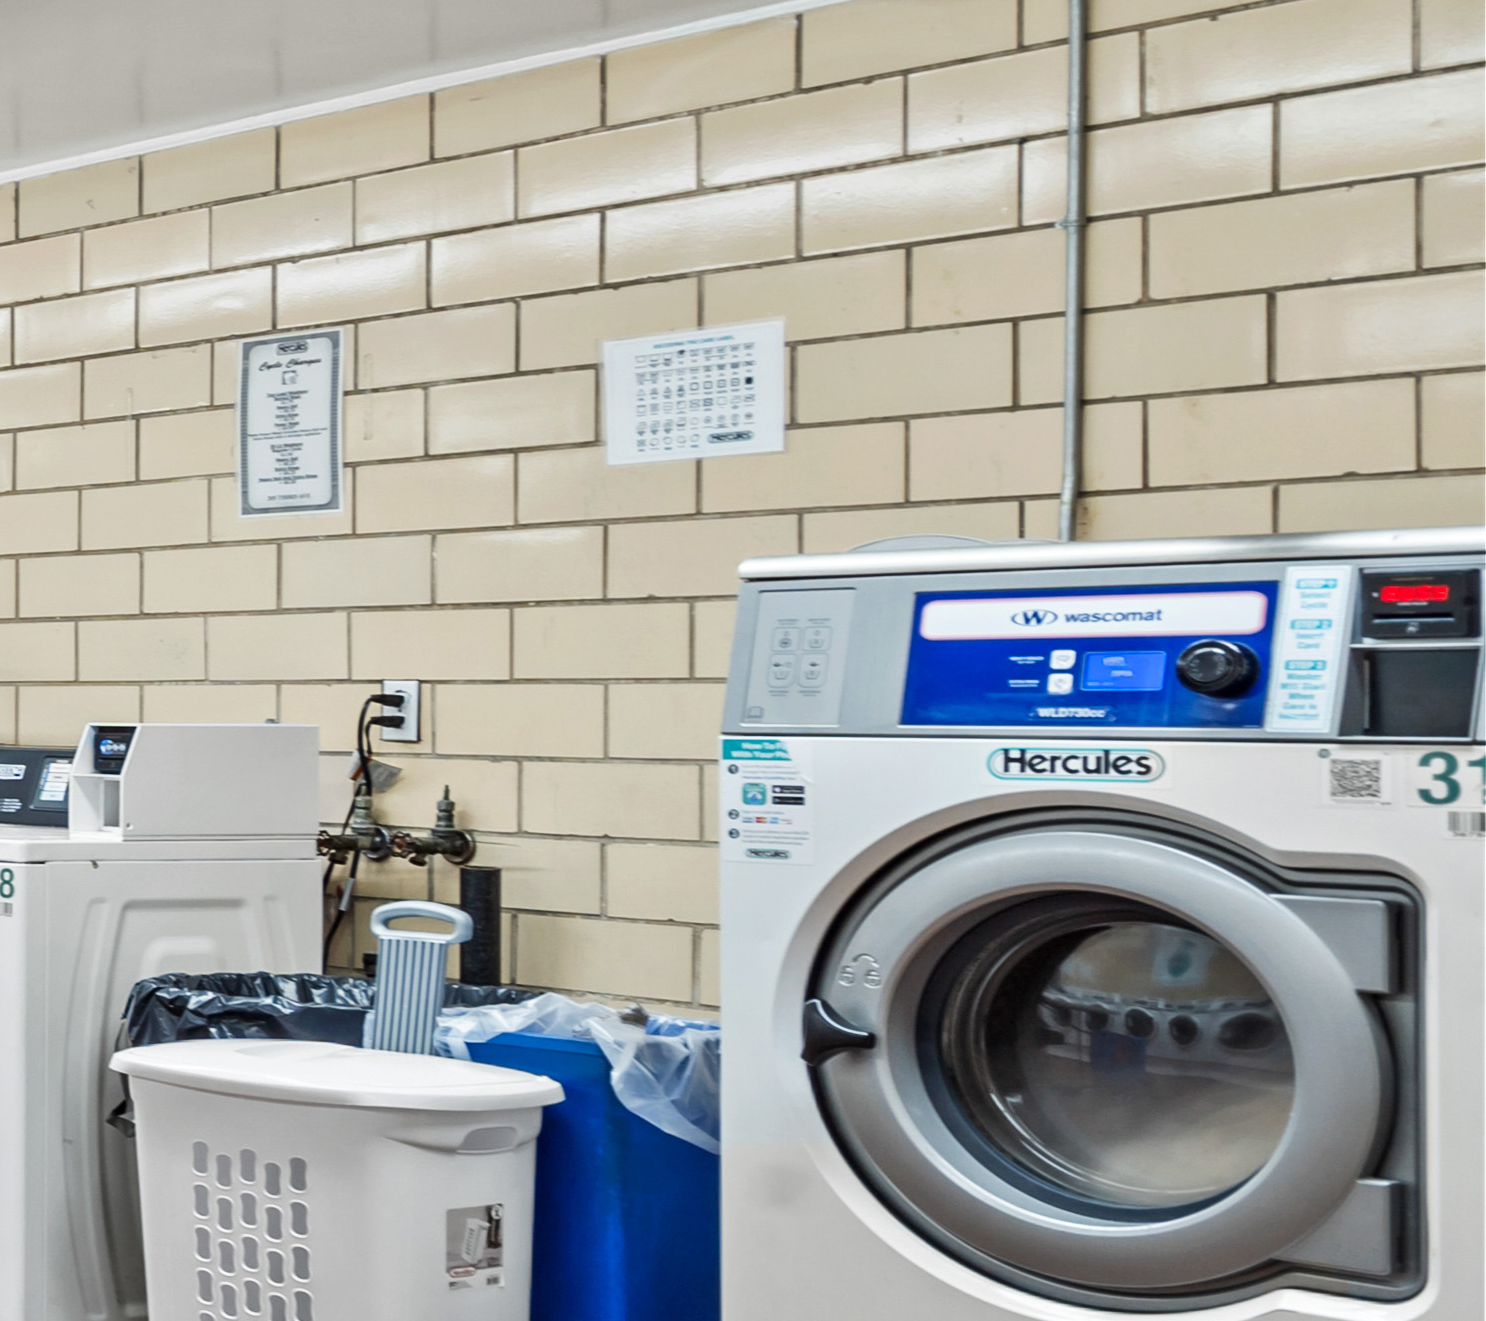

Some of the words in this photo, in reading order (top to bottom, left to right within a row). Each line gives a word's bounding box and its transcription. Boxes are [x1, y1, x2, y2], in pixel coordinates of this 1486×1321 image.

[259, 361, 282, 371] Cycle
[286, 358, 322, 369] Charges
[1065, 609, 1163, 624] wascomat
[1036, 708, 1106, 718] WLD730cc
[1003, 749, 1152, 776] Hercules
